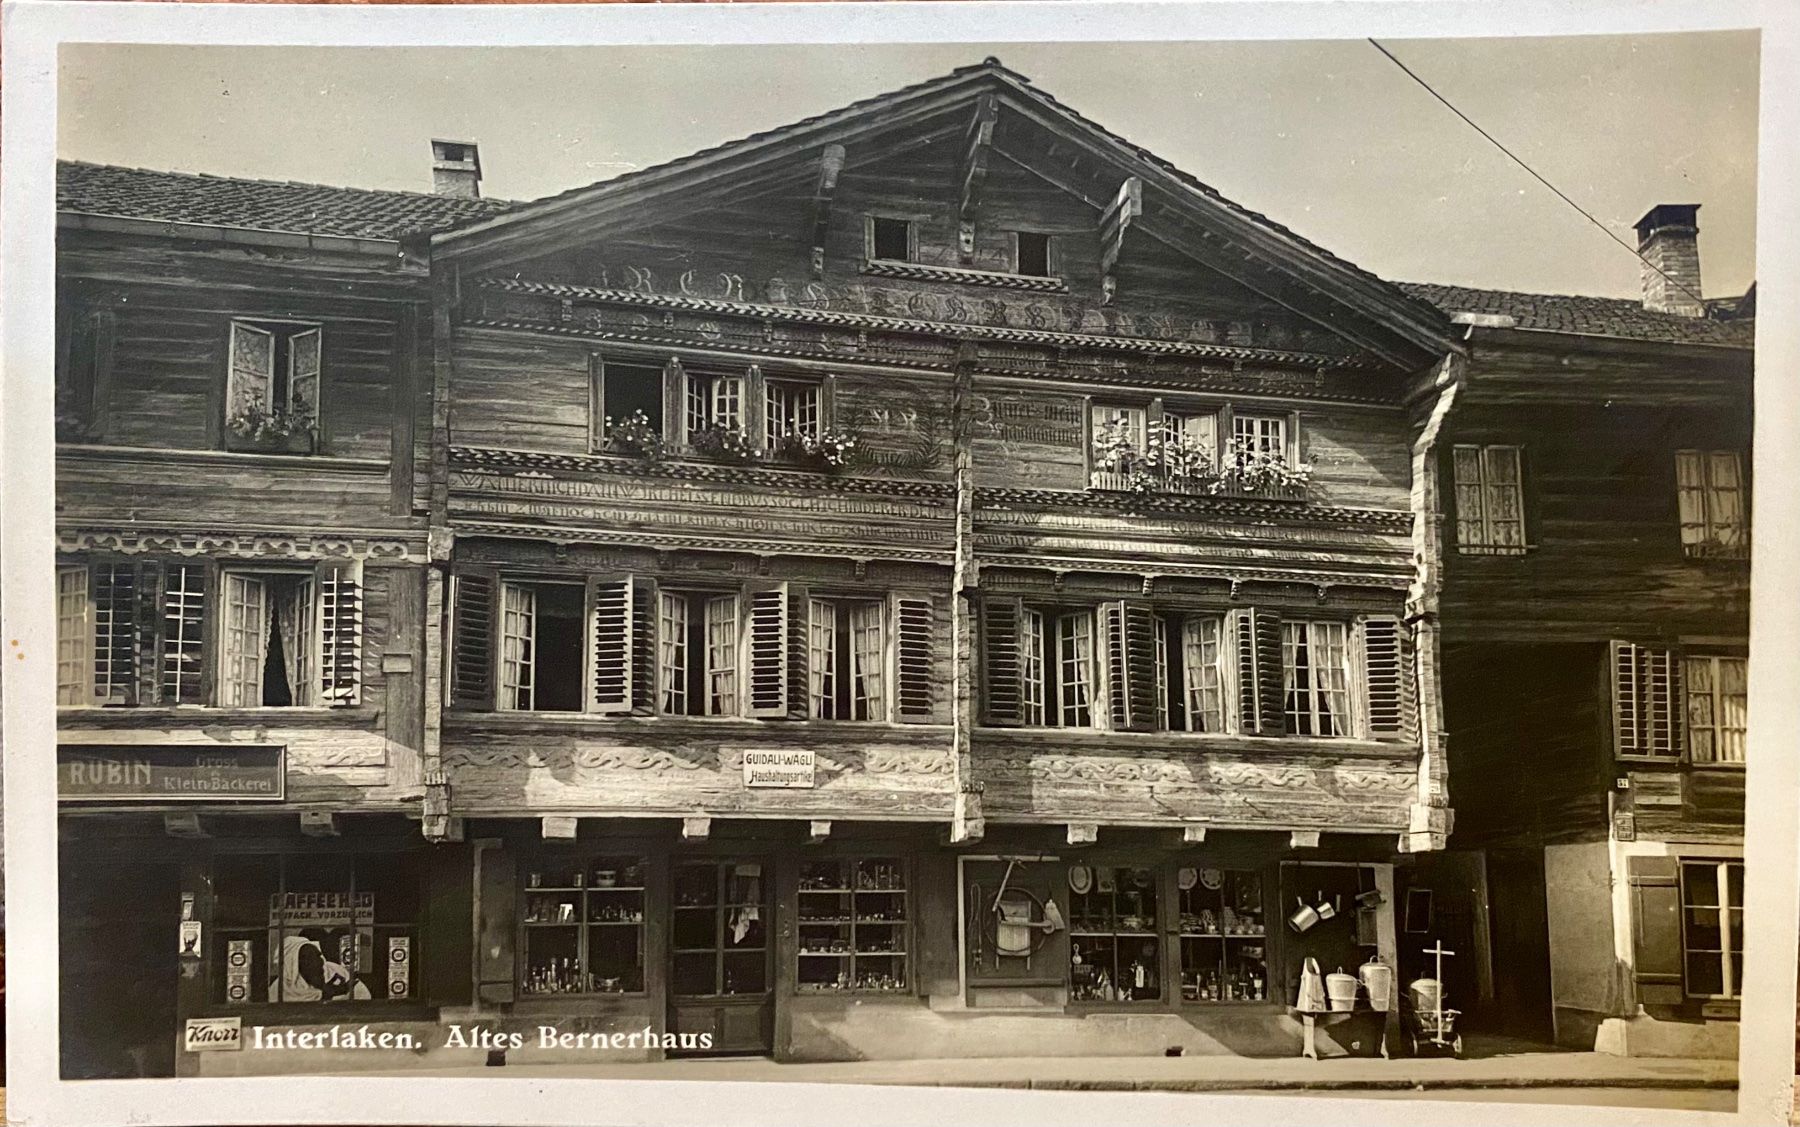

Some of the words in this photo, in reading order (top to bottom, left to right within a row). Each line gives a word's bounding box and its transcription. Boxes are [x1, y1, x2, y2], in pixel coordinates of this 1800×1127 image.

[70, 759, 152, 785] RUBIN
[338, 893, 373, 908] HG
[187, 1025, 240, 1043] Knorr
